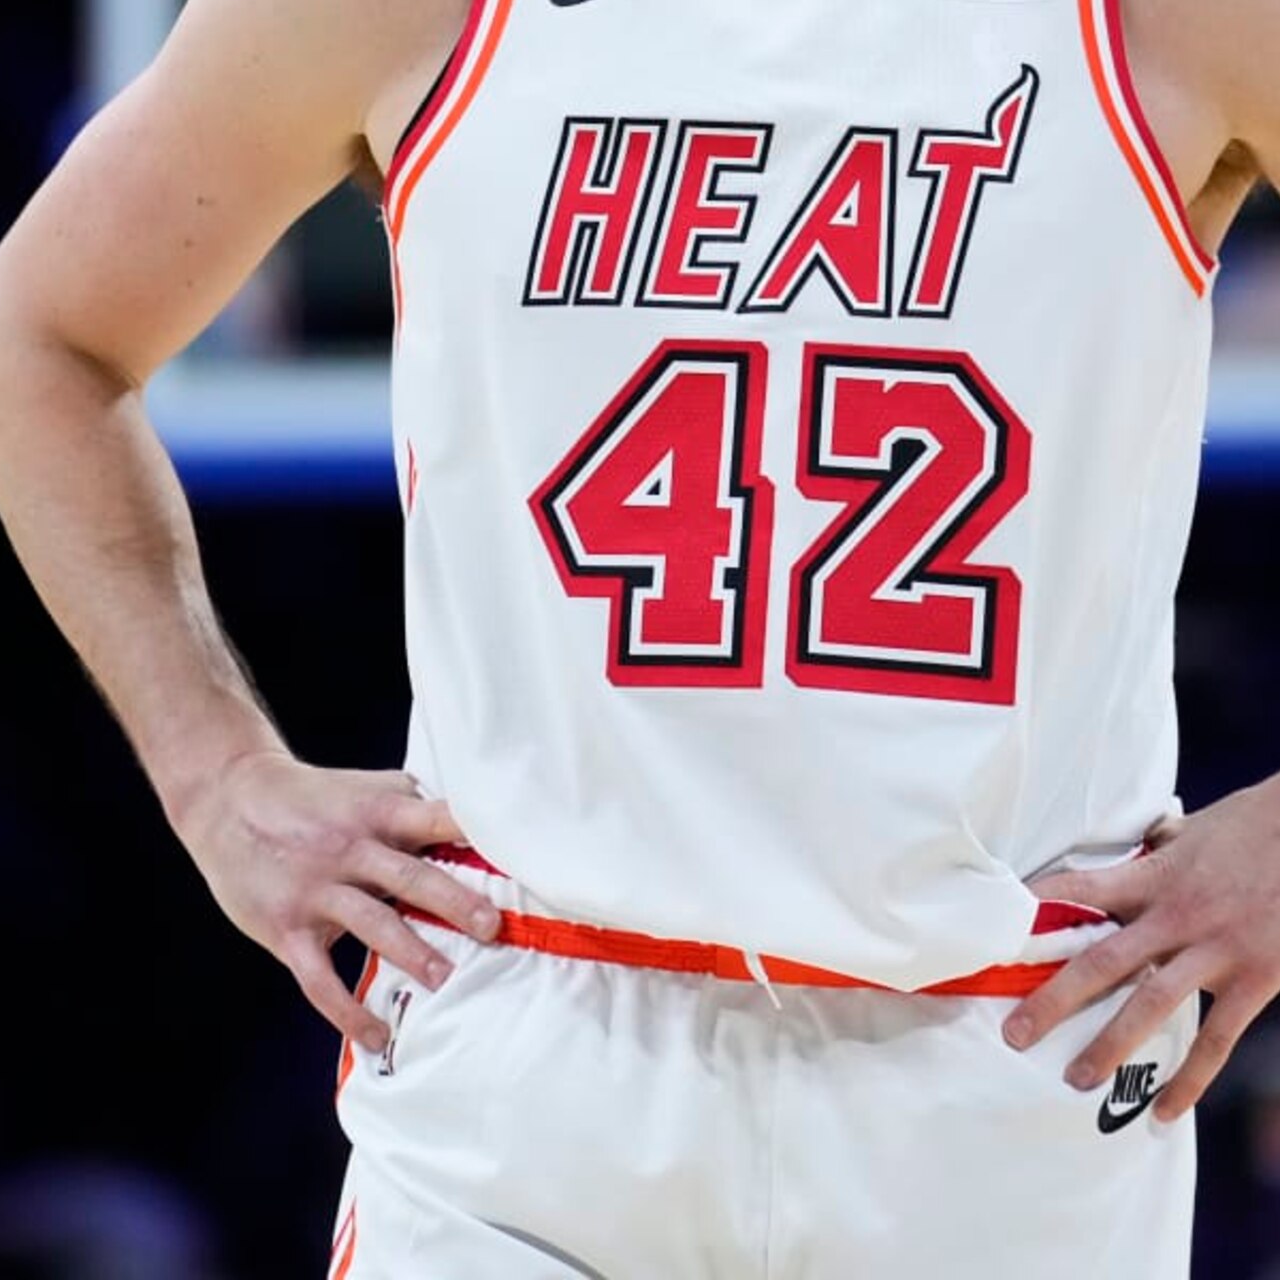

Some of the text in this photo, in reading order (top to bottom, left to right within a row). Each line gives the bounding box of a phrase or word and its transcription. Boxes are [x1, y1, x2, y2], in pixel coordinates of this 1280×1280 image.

[521, 63, 1040, 319] HEAT
[527, 338, 1032, 706] 42
[1110, 1061, 1159, 1104] NIKE
